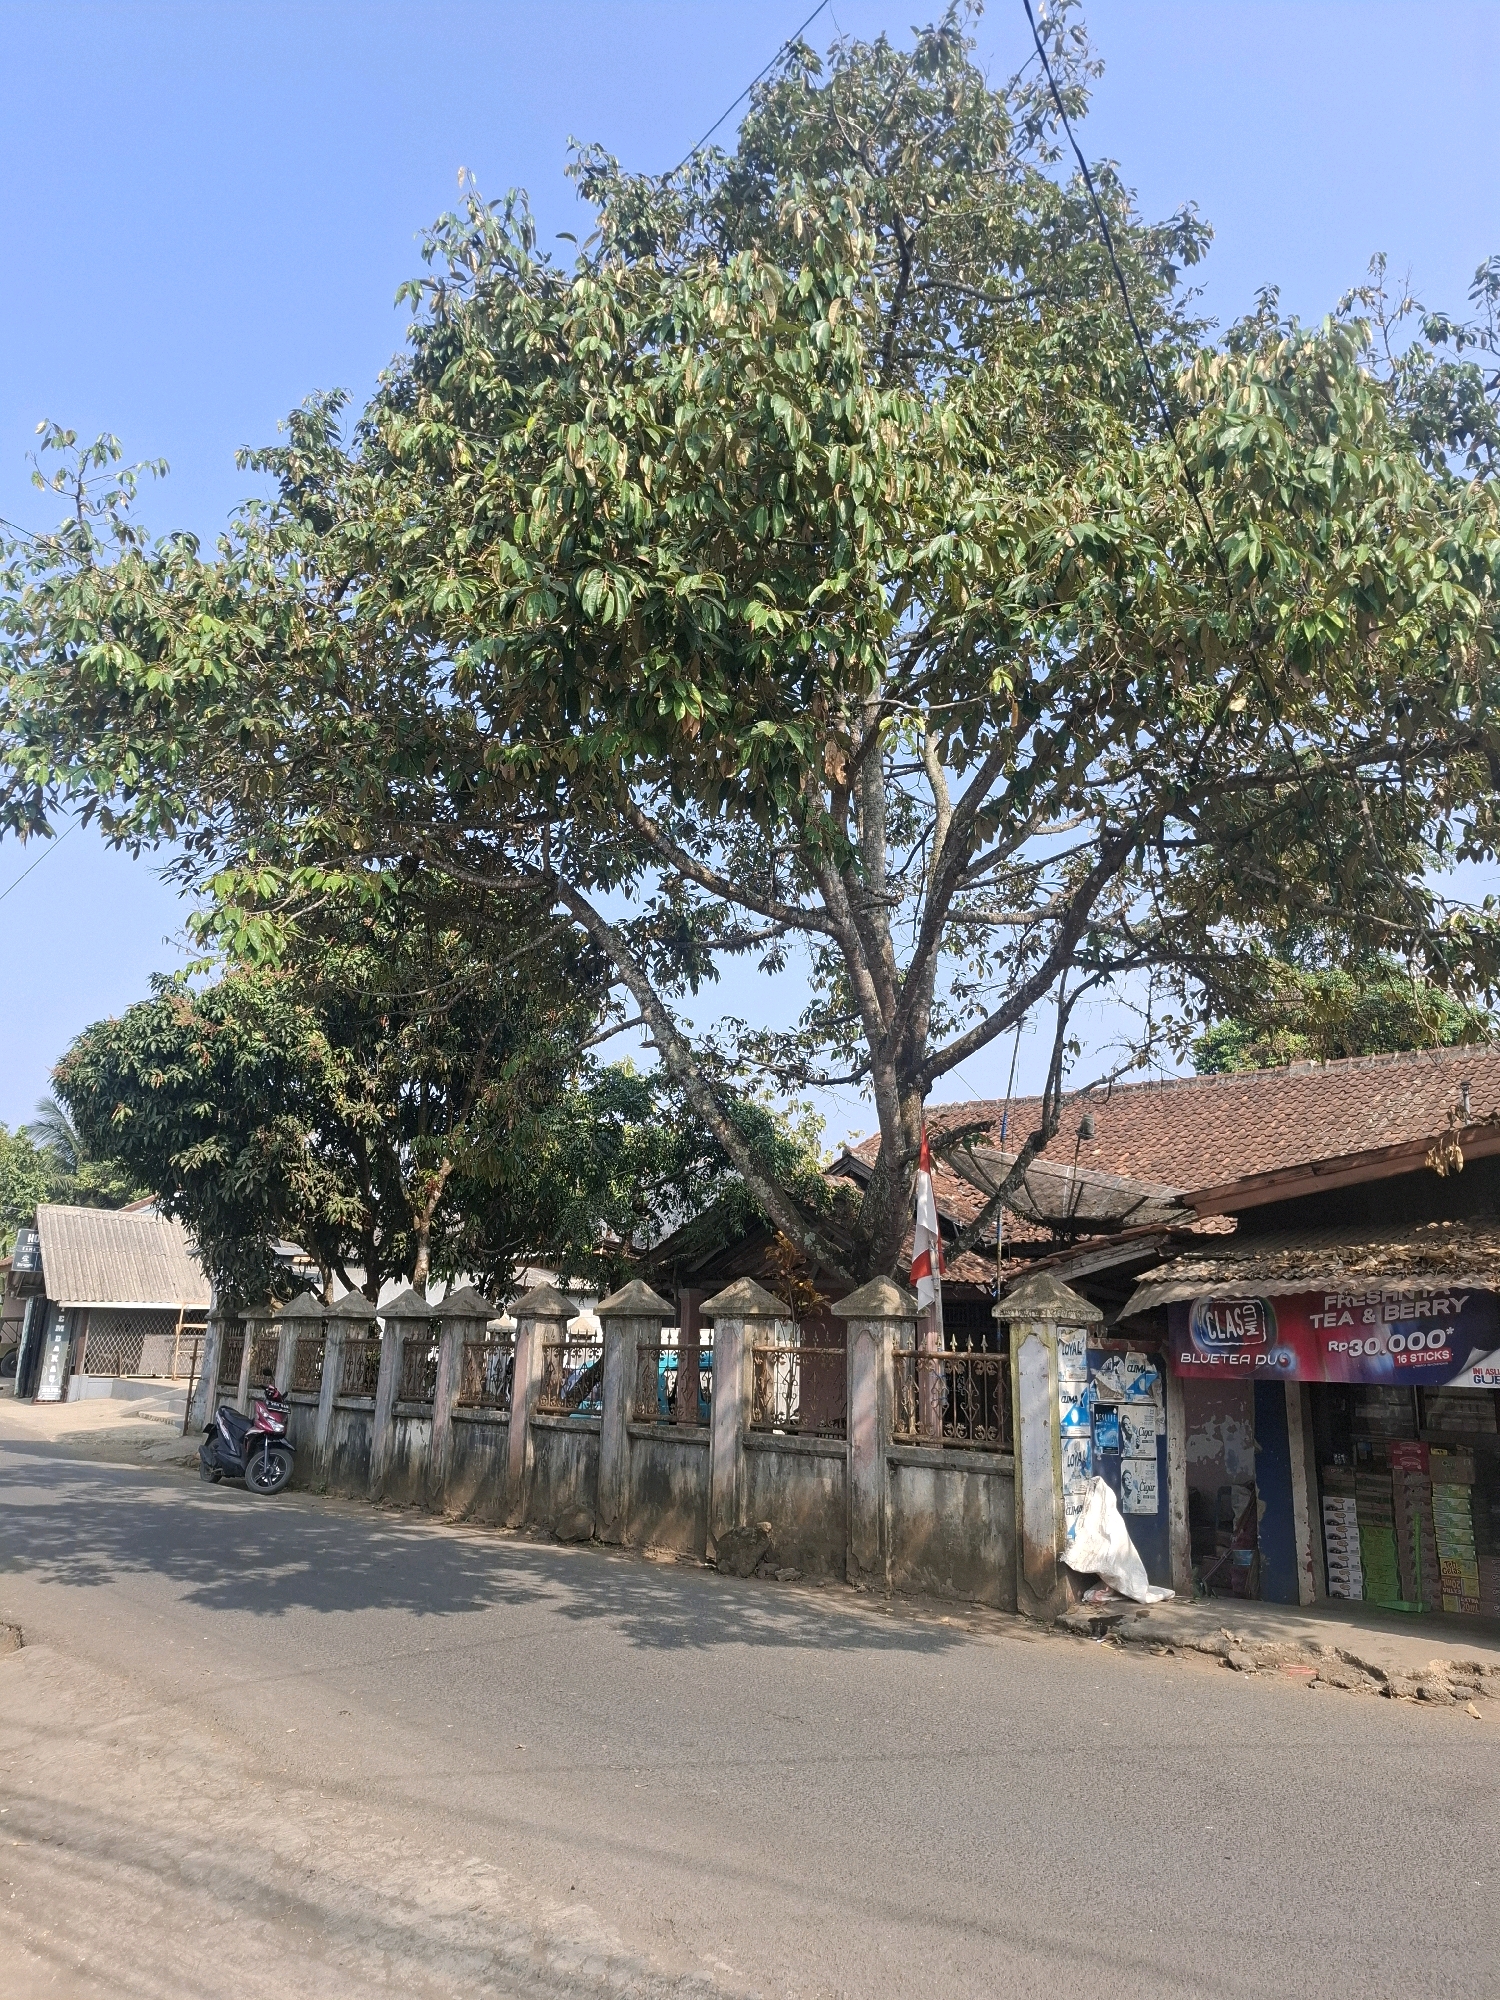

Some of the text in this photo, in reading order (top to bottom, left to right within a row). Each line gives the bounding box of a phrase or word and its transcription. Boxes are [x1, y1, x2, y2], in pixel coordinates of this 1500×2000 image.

[1205, 1307, 1244, 1339] CLAS
[1242, 1304, 1259, 1336] MILD
[1309, 1295, 1470, 1328] TEA & BERRY
[1180, 1353, 1251, 1364] BLUETEA
[1396, 1349, 1450, 1364] 16 STICKS
[1472, 1367, 1483, 1375] INI
